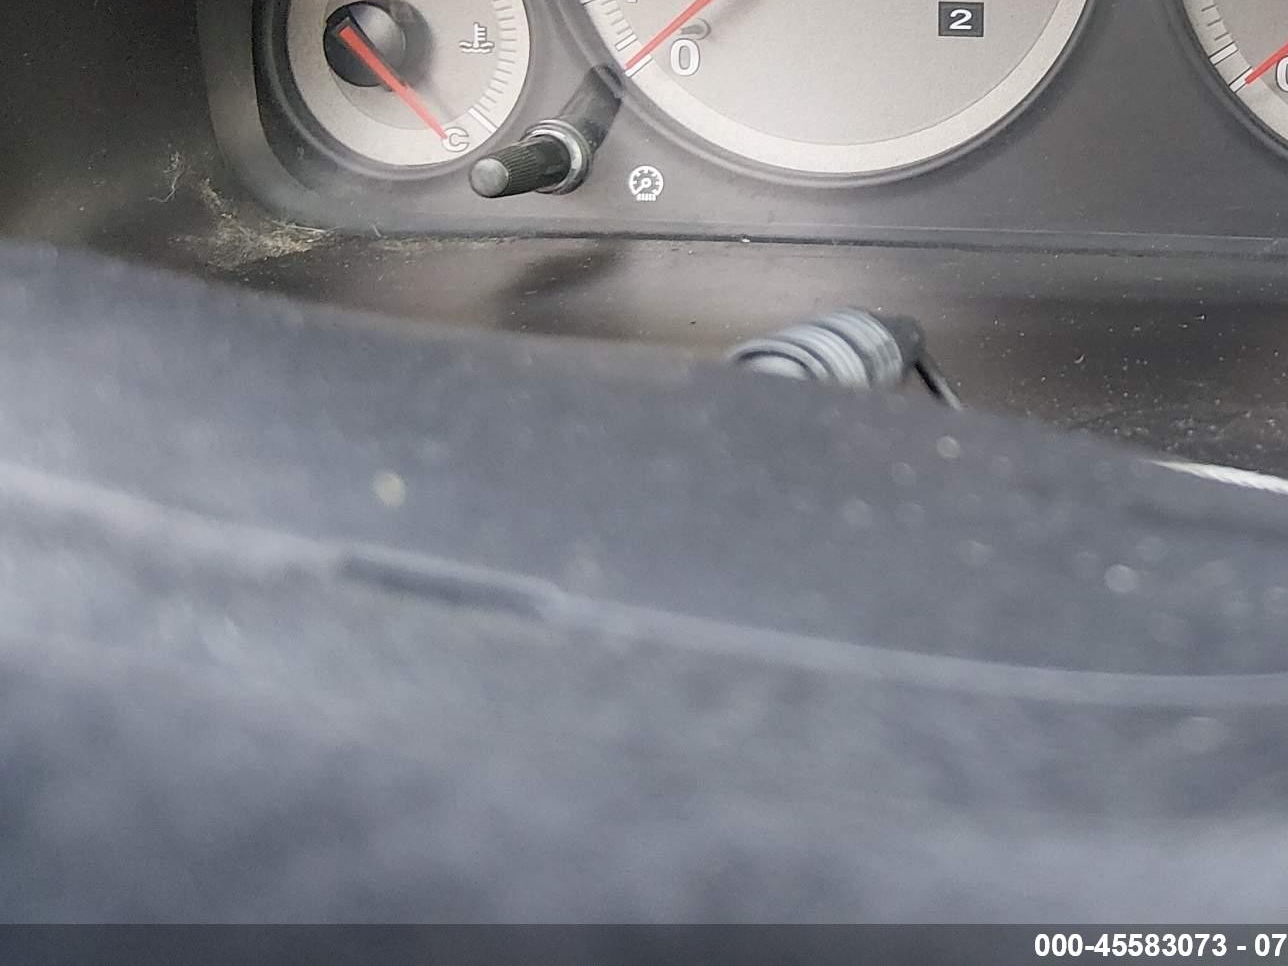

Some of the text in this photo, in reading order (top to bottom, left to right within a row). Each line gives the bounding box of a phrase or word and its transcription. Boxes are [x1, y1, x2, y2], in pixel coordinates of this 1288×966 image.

[949, 9, 972, 29] 2
[669, 39, 700, 76] 0
[442, 128, 470, 152] C
